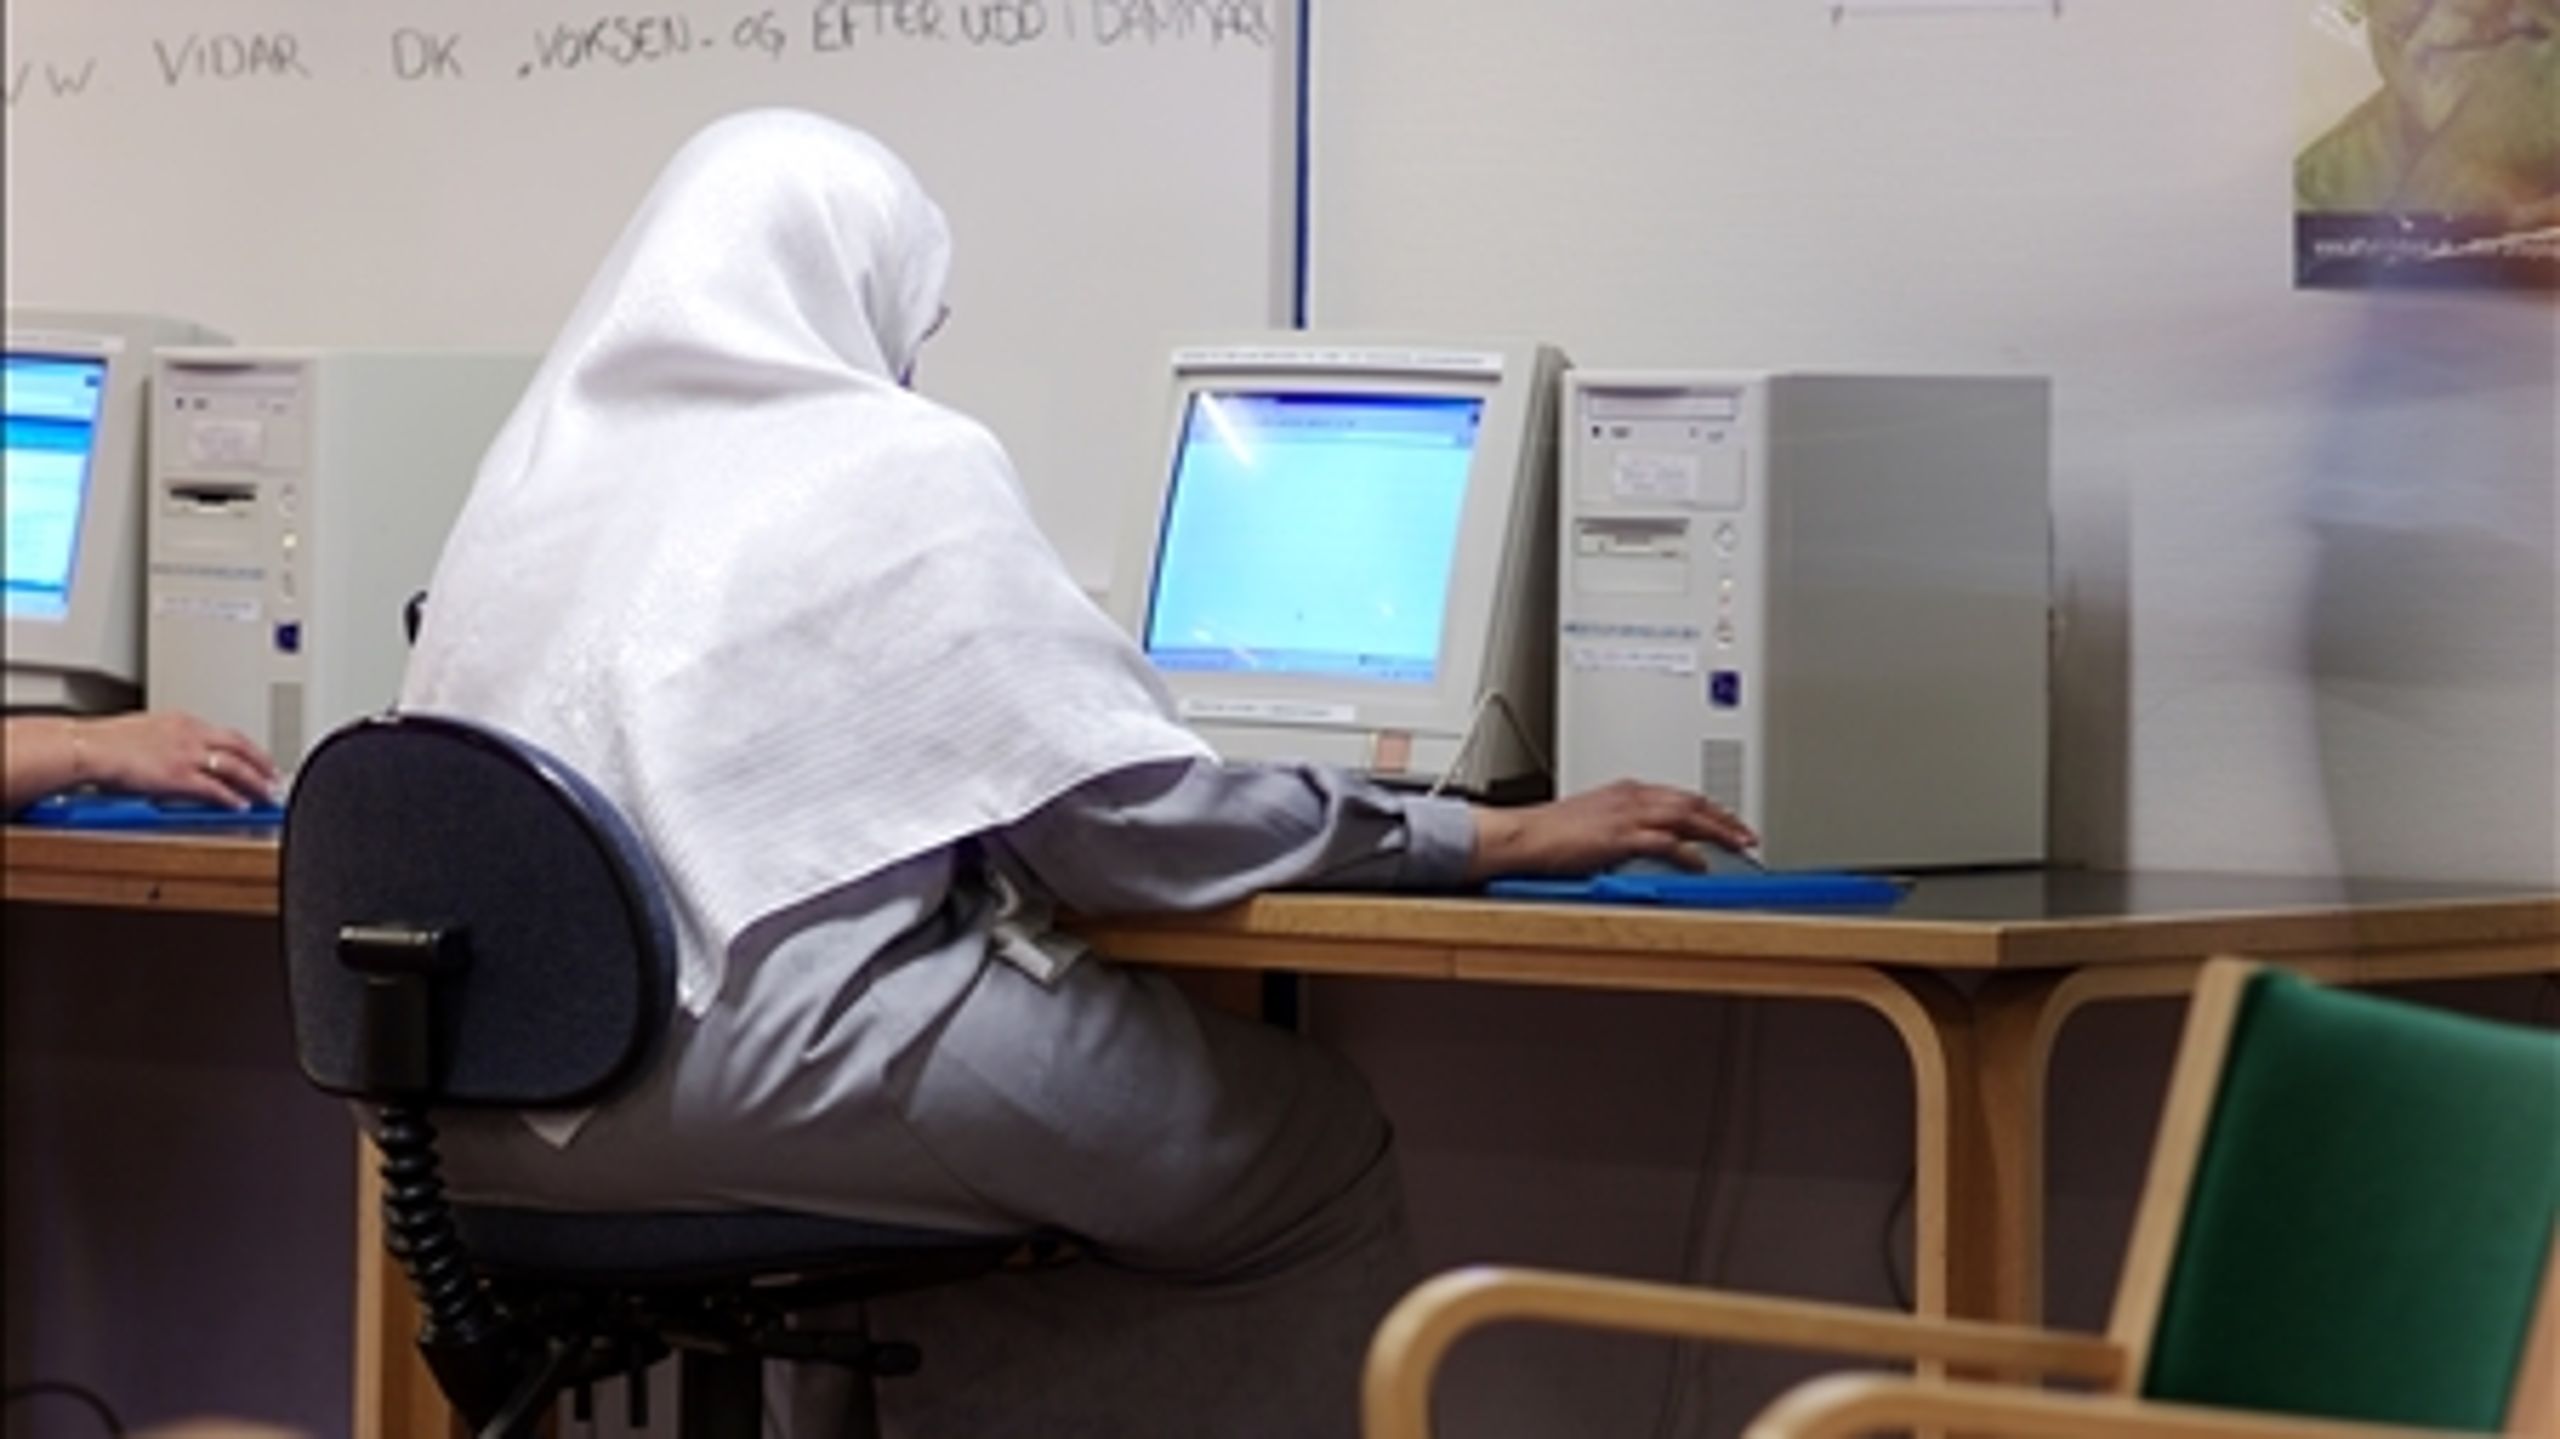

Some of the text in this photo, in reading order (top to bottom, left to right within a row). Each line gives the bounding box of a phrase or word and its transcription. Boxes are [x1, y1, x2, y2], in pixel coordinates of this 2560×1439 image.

[152, 33, 312, 87] VIDAR
[392, 27, 461, 80] DK
[733, 9, 786, 62] OG
